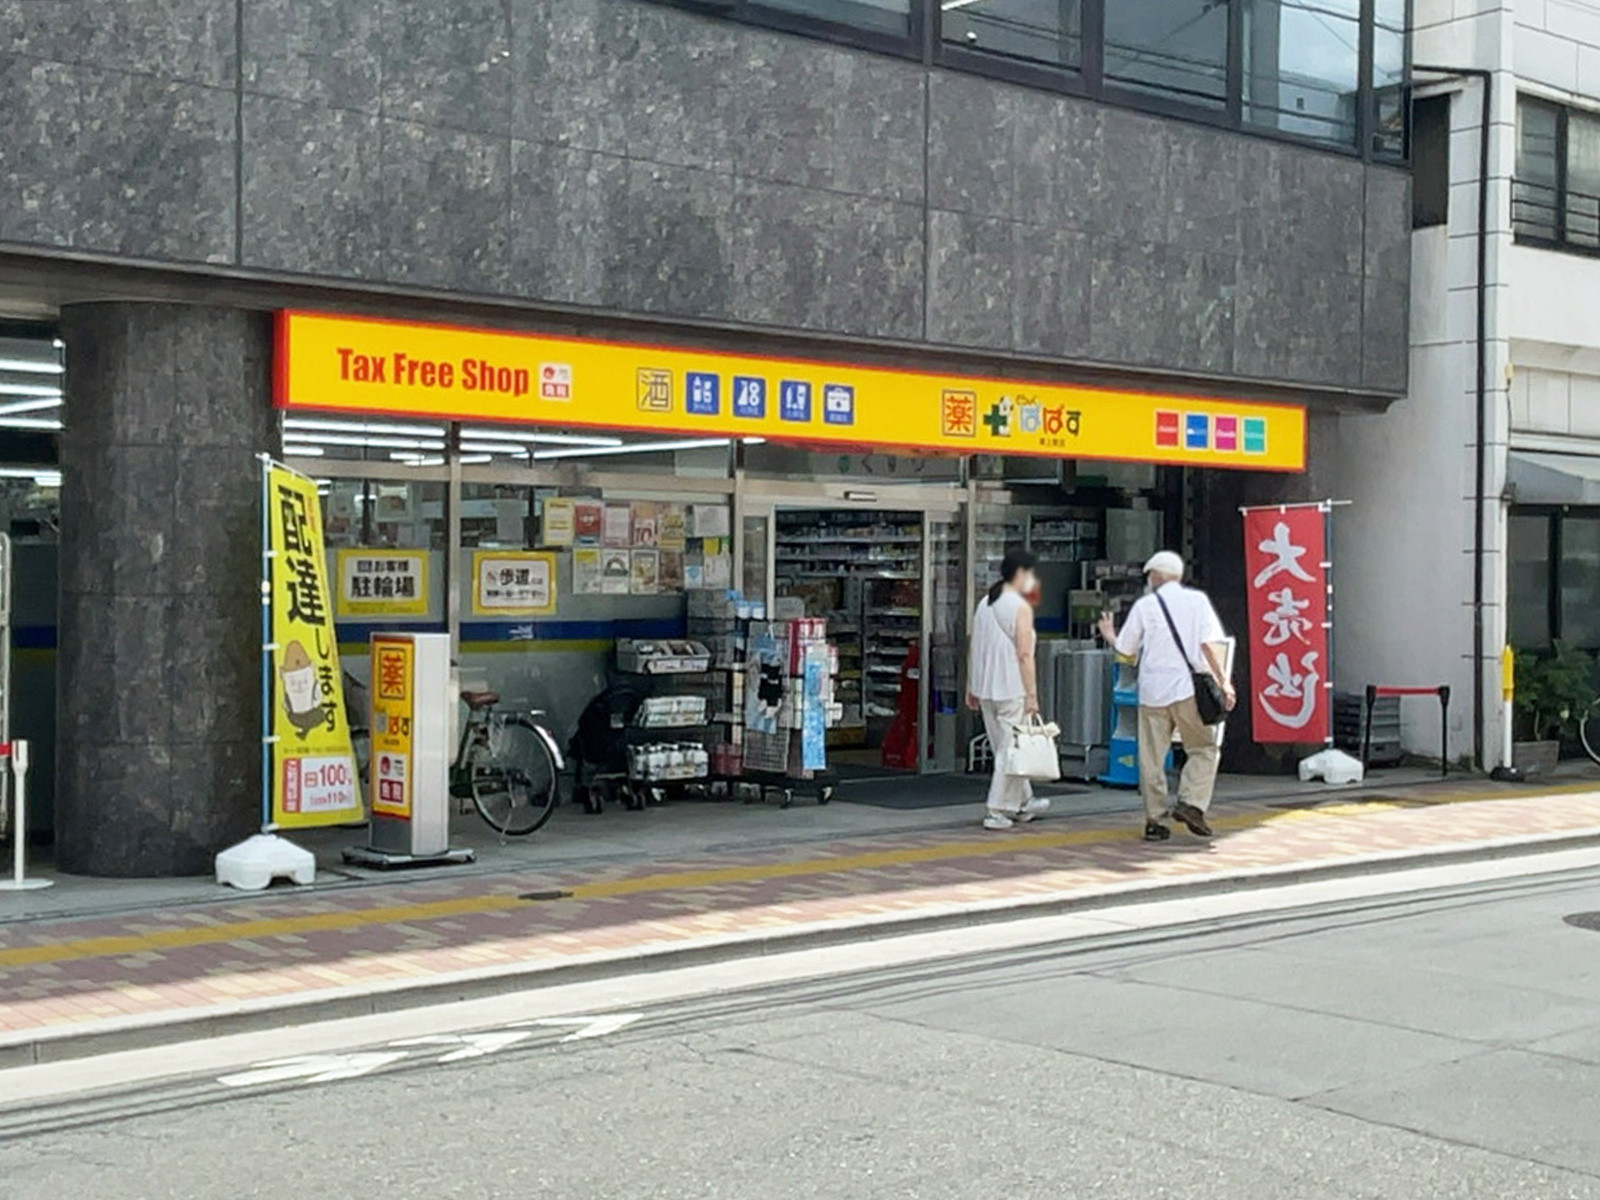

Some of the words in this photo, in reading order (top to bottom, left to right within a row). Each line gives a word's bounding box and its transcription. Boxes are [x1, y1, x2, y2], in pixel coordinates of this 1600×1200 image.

[337, 347, 386, 384] Tax
[393, 352, 454, 388] Free
[461, 358, 529, 397] Shop
[640, 370, 669, 408] 酒
[946, 395, 973, 432] 薬
[351, 576, 415, 598] 駐輪場
[382, 654, 403, 693] 薬
